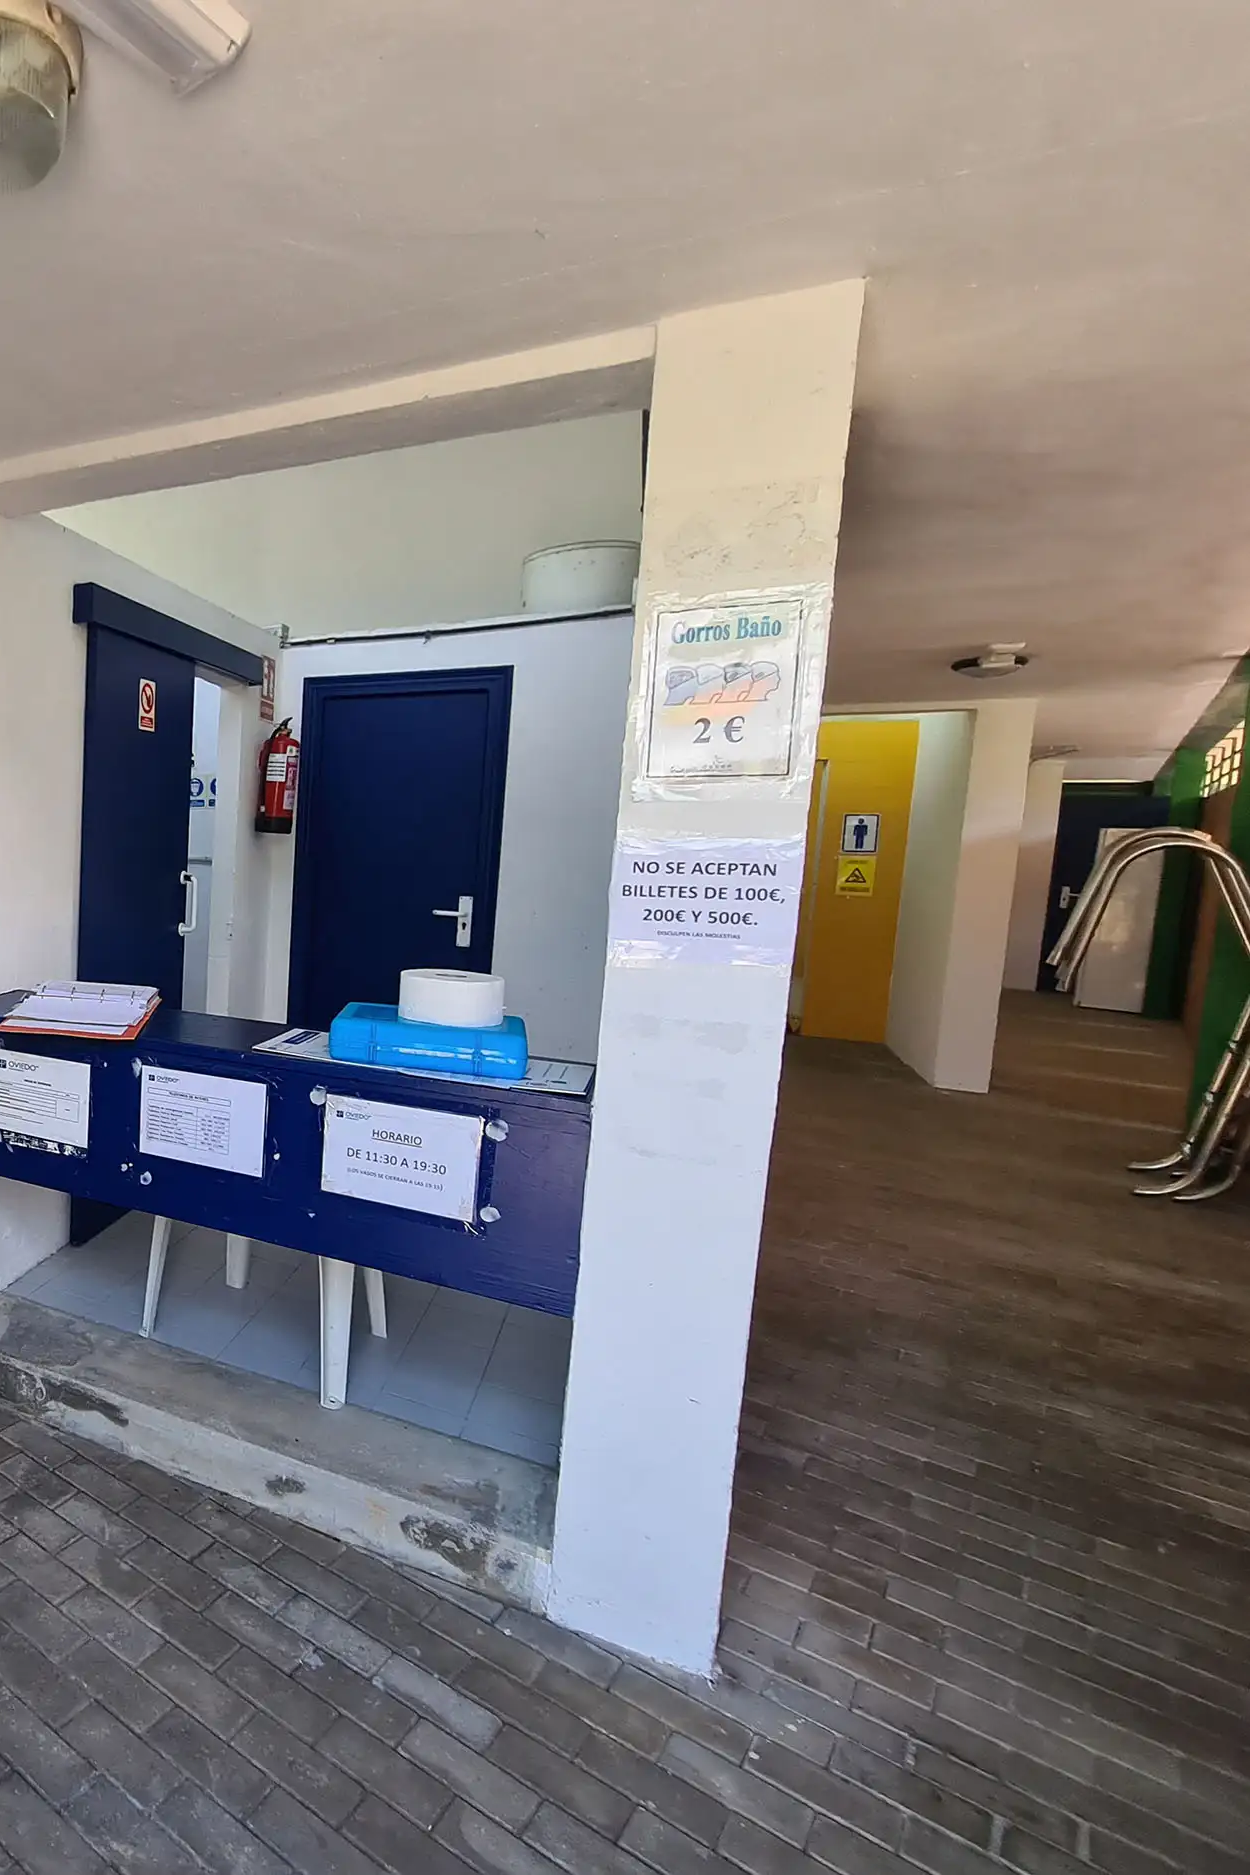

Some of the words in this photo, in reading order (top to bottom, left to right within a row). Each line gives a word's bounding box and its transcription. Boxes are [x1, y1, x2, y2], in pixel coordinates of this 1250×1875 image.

[671, 621, 731, 644] Gorros
[735, 616, 782, 640] Baño
[693, 717, 711, 744] 2
[723, 716, 746, 743] €
[632, 861, 660, 874] NO
[665, 862, 686, 875] SE
[691, 862, 777, 877] ACEPTAN
[622, 884, 699, 899] BILLETES
[704, 887, 728, 900] DE
[734, 887, 786, 904] 100€,
[642, 908, 687, 923] 200€
[691, 910, 702, 923] Y
[707, 911, 759, 926] 500€.
[8, 1060, 37, 1072] OVIEDO
[372, 1128, 423, 1146] HORARIO
[347, 1147, 362, 1159] DE
[365, 1151, 398, 1166] 11:30
[400, 1157, 410, 1168] A
[413, 1160, 447, 1175] 19:30
